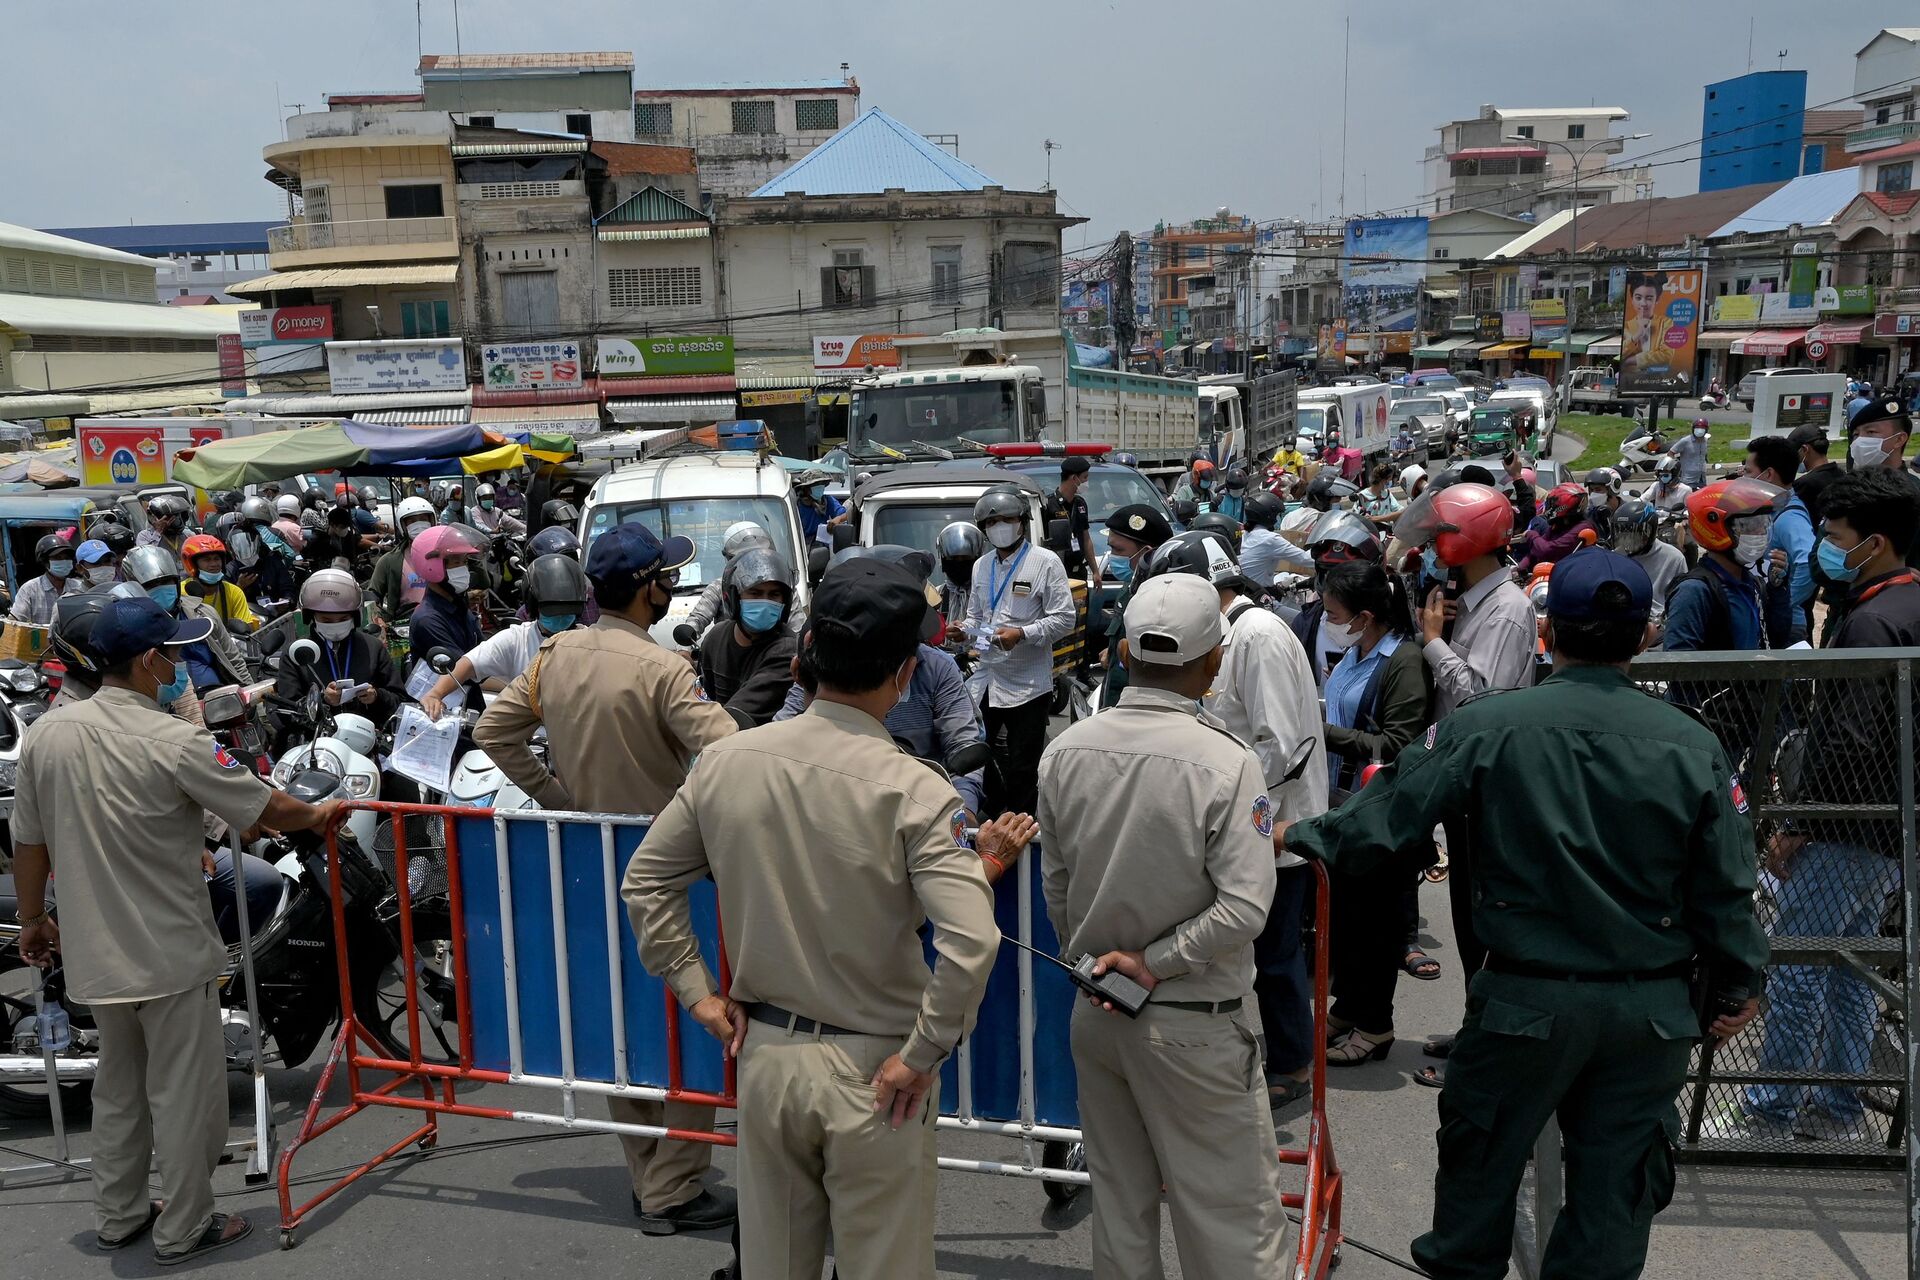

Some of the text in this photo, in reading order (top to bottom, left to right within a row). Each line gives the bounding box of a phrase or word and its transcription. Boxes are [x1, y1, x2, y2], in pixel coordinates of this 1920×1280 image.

[1662, 274, 1698, 295] 4U
[1821, 294, 1835, 306] Wing
[291, 317, 325, 330] money
[821, 341, 844, 350] true
[1811, 345, 1823, 355] 40
[605, 350, 636, 366] Wing
[821, 350, 844, 358] money
[1211, 561, 1231, 572] INDEX
[287, 938, 326, 947] HONDA
